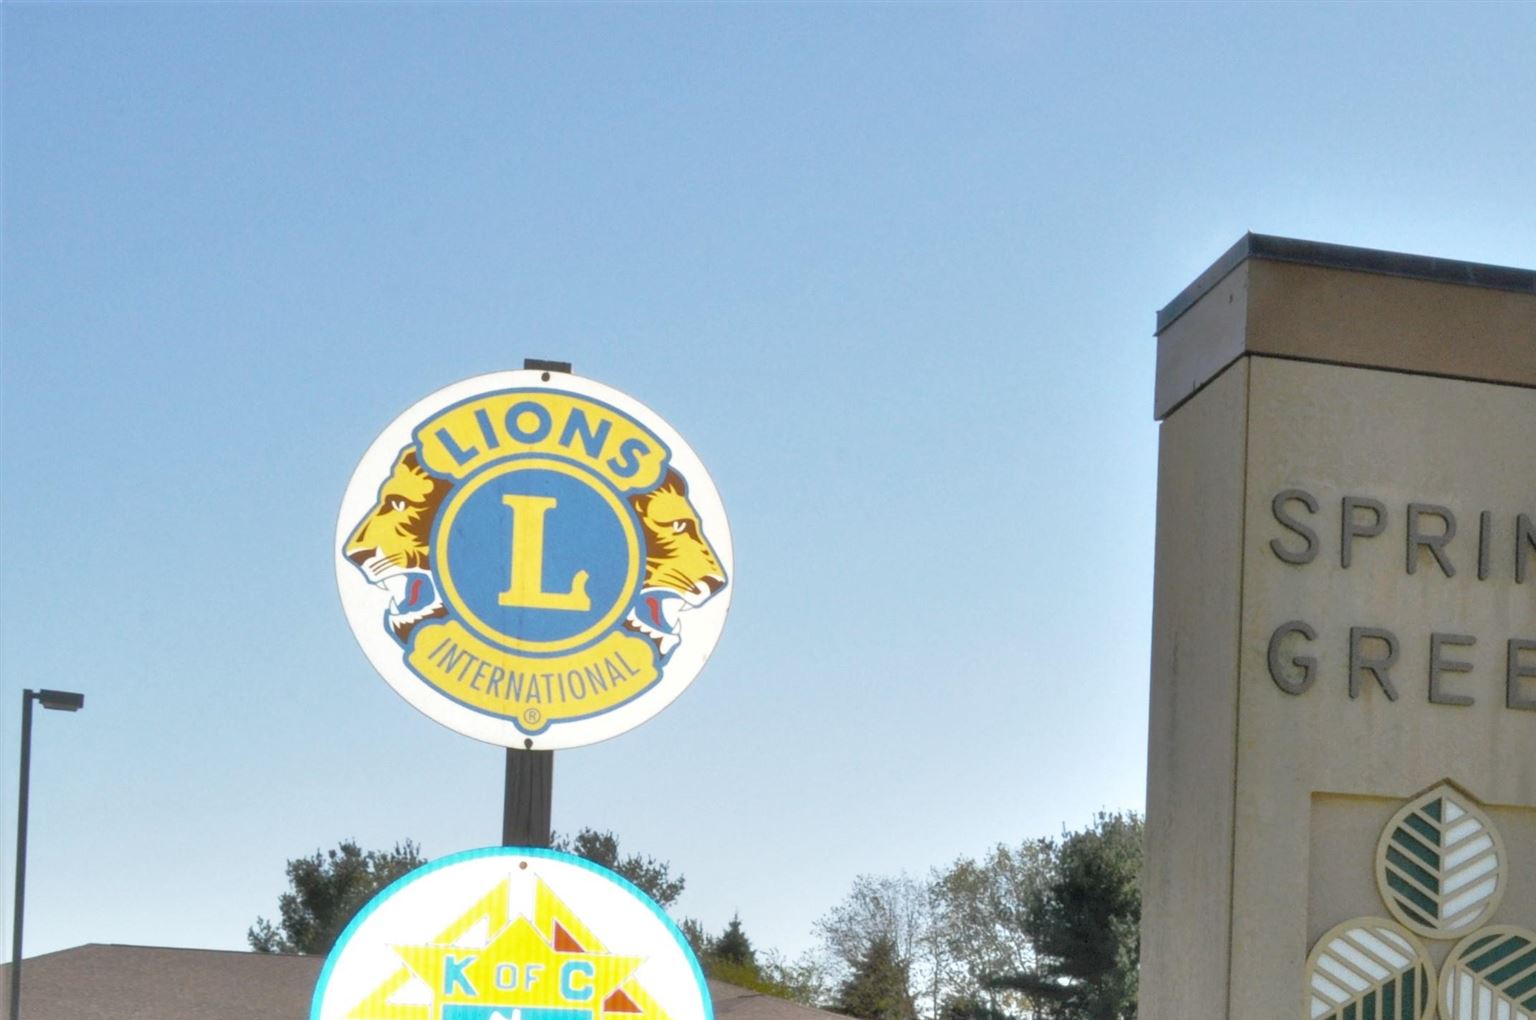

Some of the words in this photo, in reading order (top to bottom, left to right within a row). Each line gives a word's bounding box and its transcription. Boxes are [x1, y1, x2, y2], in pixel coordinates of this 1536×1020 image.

[434, 400, 651, 479] LIONS
[498, 494, 591, 612] L
[427, 637, 641, 705] INTERNATIONAL
[443, 955, 478, 997] K
[494, 963, 544, 992] OF
[560, 960, 594, 1001] C
